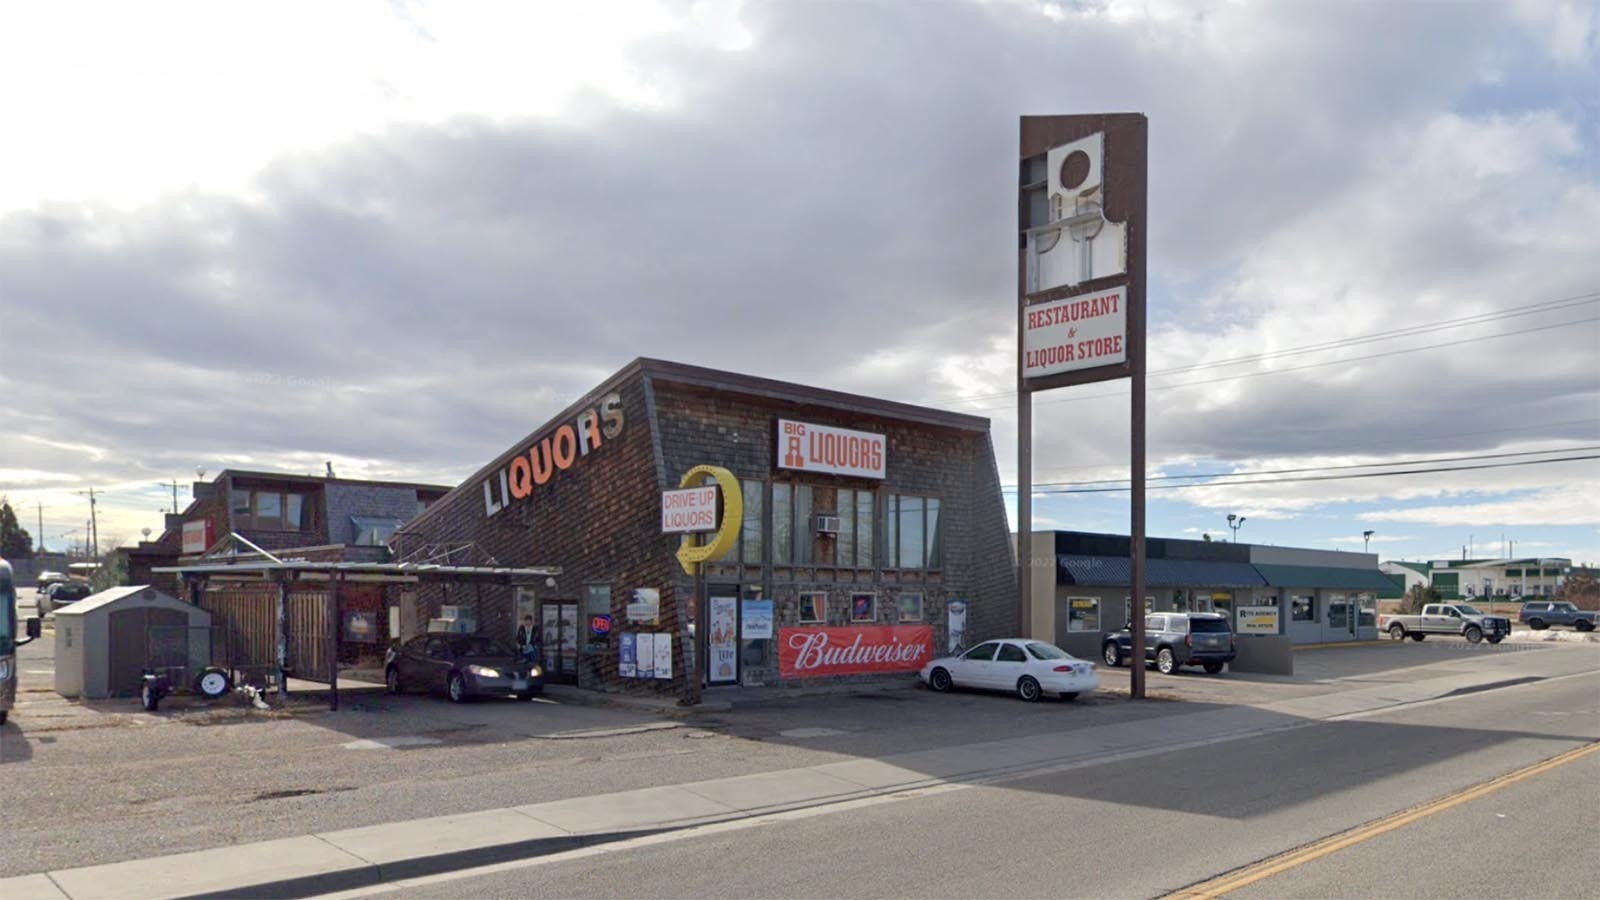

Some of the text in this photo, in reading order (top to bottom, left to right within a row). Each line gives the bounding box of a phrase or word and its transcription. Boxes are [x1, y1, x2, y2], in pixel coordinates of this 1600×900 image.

[1028, 294, 1120, 330] RESTAURANT
[1067, 327, 1077, 338] &
[1026, 336, 1122, 369] LIQUOR STORE
[784, 422, 806, 436] BIG
[483, 393, 625, 517] LIQUORS
[809, 431, 882, 472] LIQUORS
[664, 510, 713, 528] LIQUORS
[788, 631, 925, 670] Budweiser
